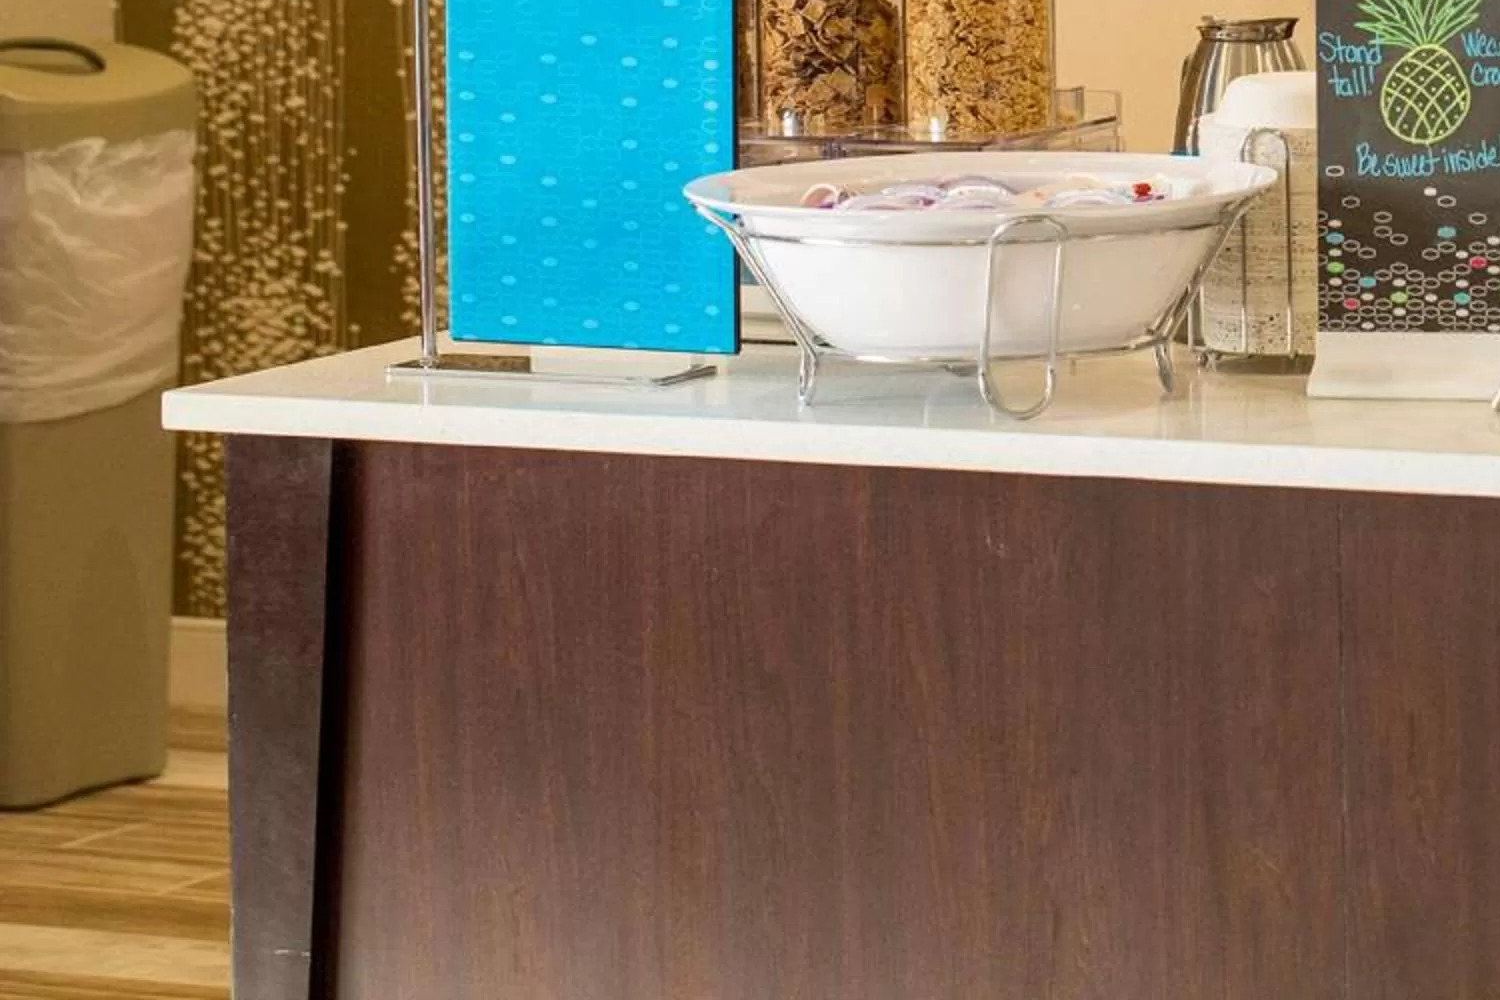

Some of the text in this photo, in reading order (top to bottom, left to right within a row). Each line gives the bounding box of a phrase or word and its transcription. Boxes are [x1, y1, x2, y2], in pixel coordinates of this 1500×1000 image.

[1319, 30, 1383, 65] Stand
[1328, 63, 1375, 97] tall!
[1356, 141, 1381, 177] Be
